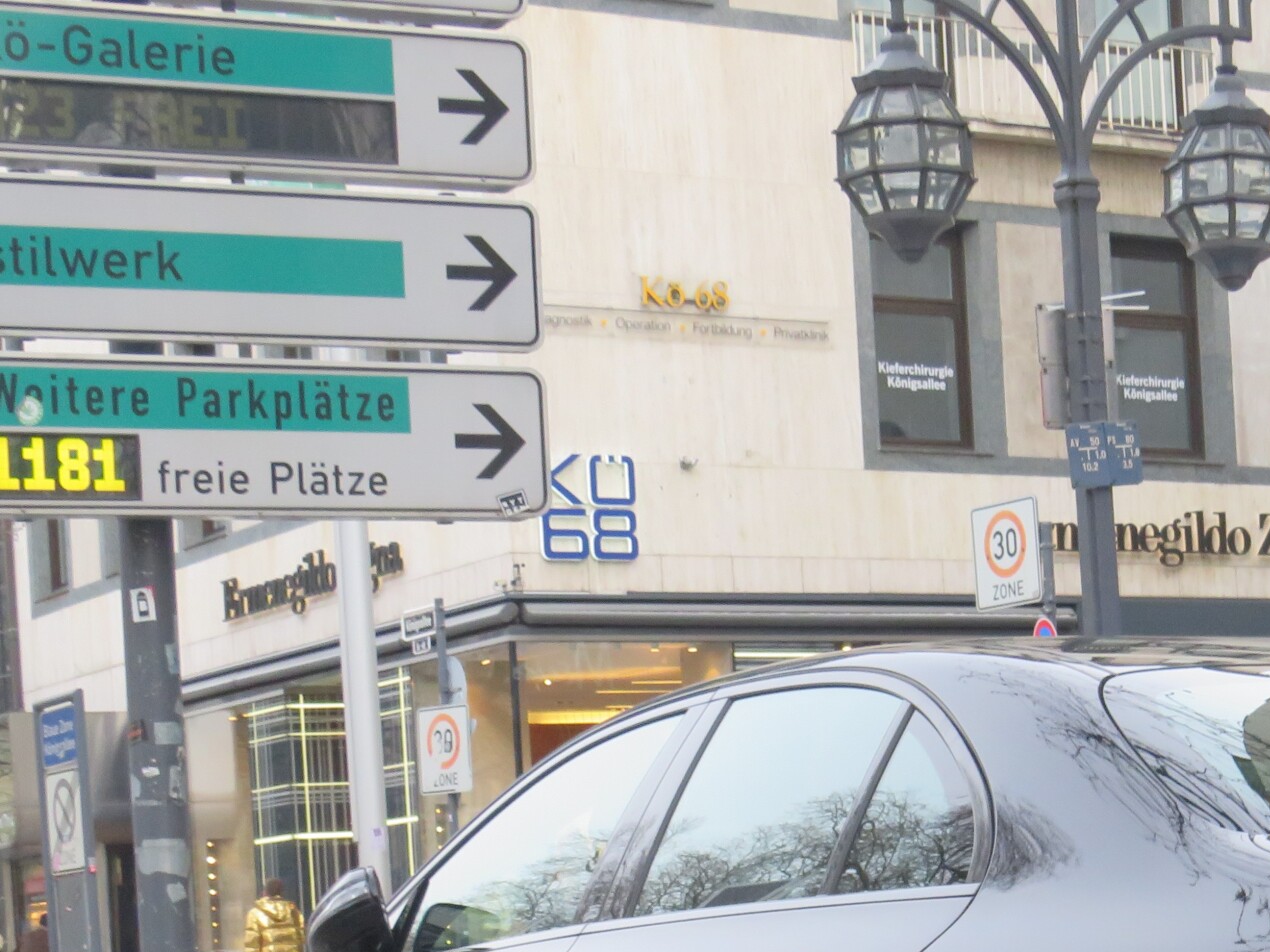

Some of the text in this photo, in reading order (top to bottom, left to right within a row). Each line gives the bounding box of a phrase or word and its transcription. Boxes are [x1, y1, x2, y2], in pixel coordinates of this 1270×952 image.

[0, 19, 235, 76] ö-Galerie
[639, 274, 731, 312] Kö 68
[614, 316, 672, 332] Operation
[692, 321, 753, 340] Fortbildung
[877, 361, 955, 380] Kieferchirurgie
[886, 375, 947, 392] Königsallee
[1116, 374, 1186, 391] Kieferchirurgie
[176, 376, 396, 430] Parkplätze
[1123, 387, 1179, 403] Königsallee
[0, 436, 126, 492] 1181
[158, 460, 389, 497] freie Plätze
[540, 508, 640, 561] 68
[993, 528, 1018, 561] 30
[991, 580, 1024, 602] ZONE
